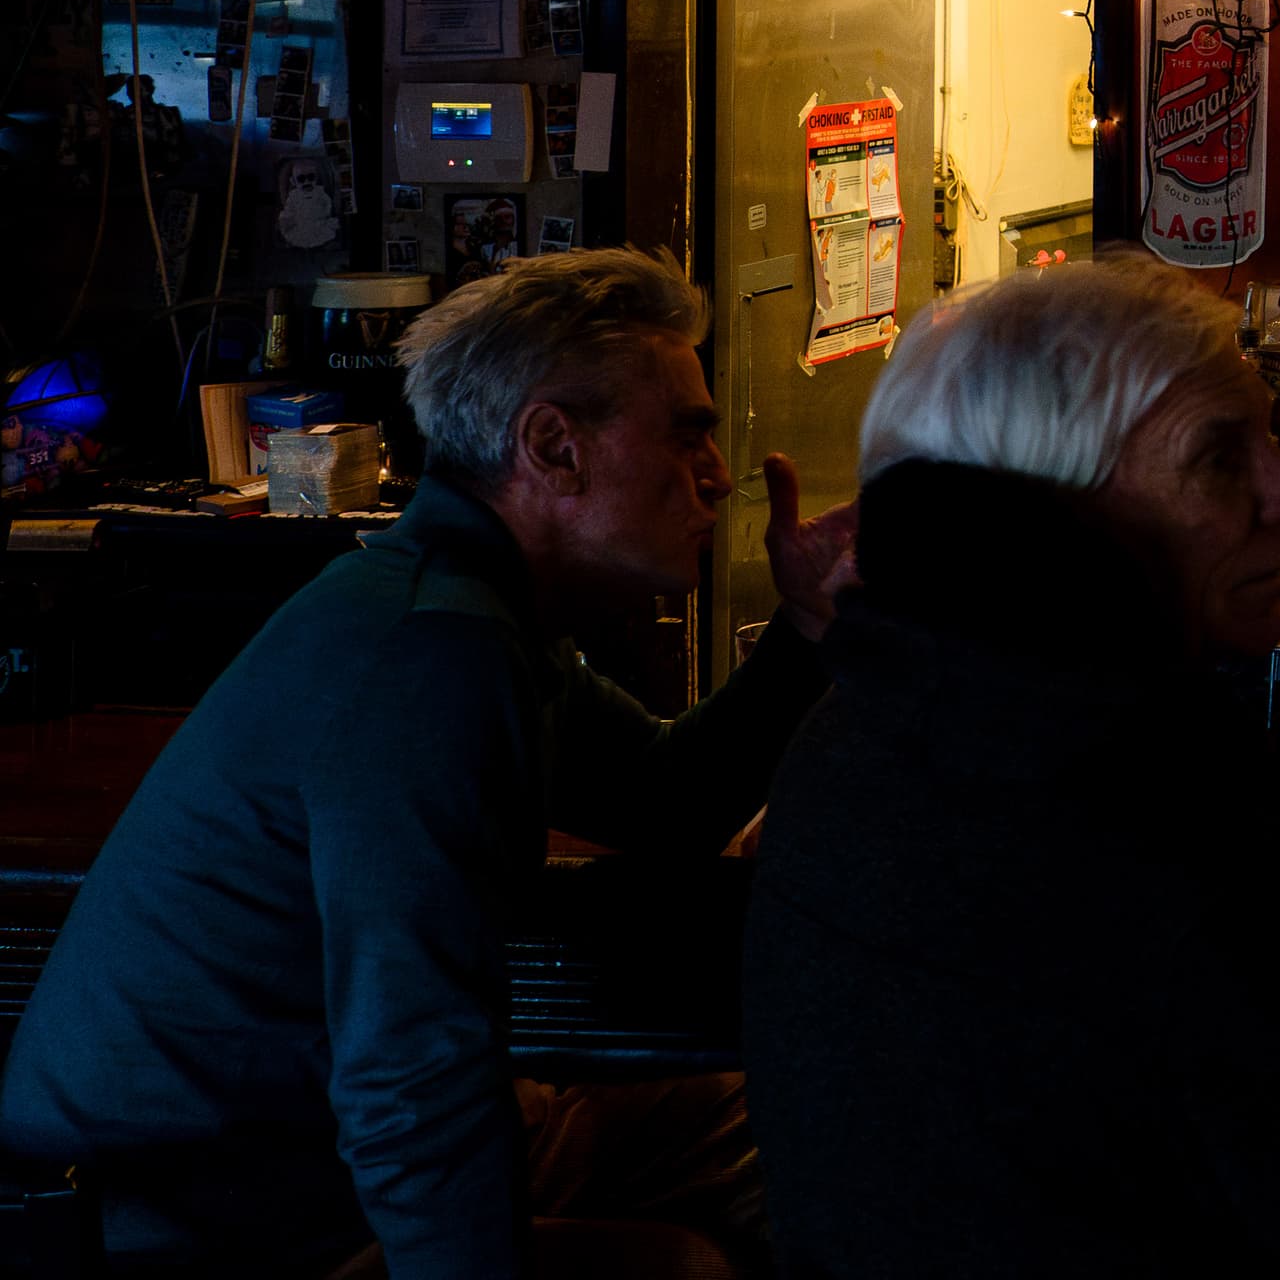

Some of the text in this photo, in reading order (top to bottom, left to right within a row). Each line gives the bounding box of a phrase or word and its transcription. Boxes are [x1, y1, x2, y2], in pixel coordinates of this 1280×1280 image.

[809, 106, 893, 128] CHOKING AID
[1151, 209, 1257, 242] LAGER
